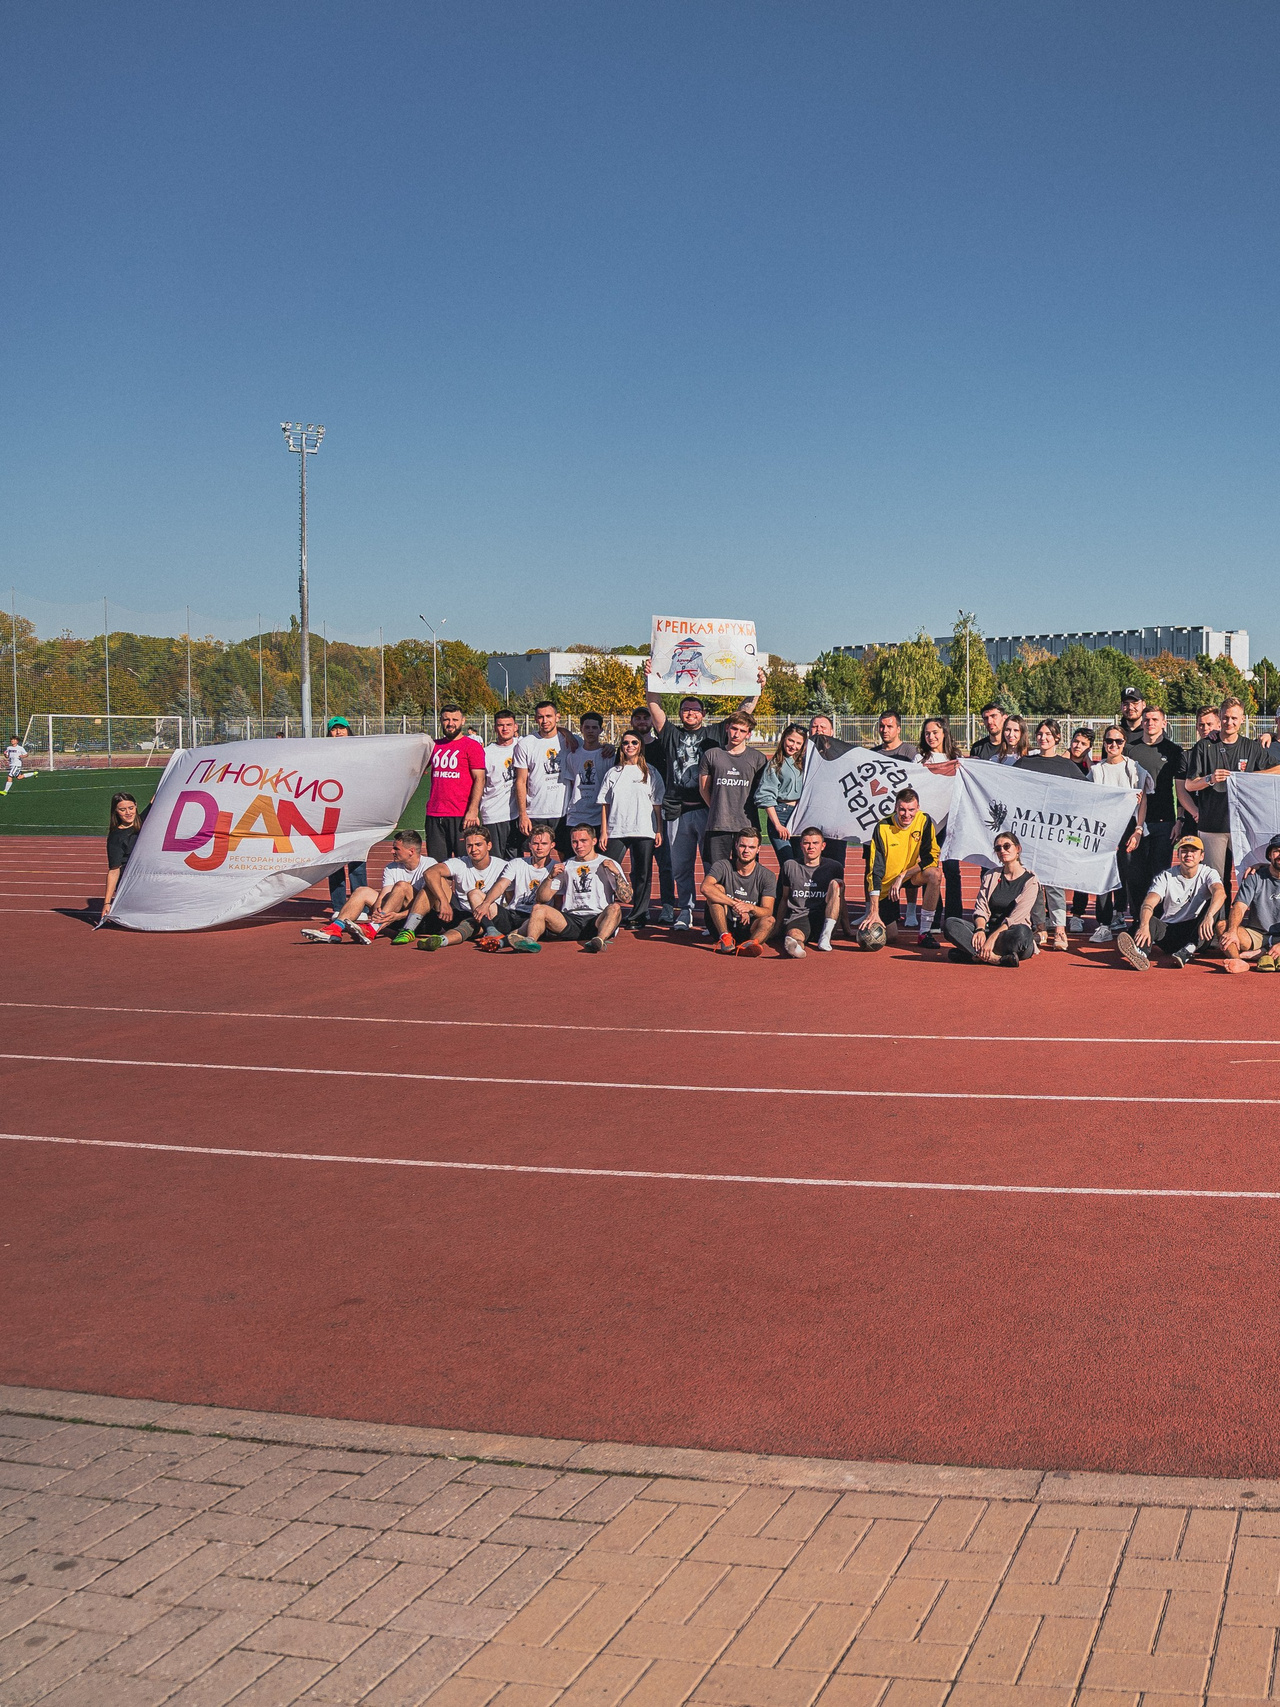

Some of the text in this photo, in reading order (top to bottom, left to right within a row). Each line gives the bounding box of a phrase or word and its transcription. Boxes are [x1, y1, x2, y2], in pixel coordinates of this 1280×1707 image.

[656, 619, 714, 635] КРЕПКАЯ
[432, 748, 460, 769] 666
[185, 758, 344, 803] ПИНОККИО
[716, 777, 750, 787] ДЭДУЛИ
[162, 790, 341, 872] DJAN
[1013, 806, 1107, 837] MADYAR
[1010, 821, 1101, 853] COLLECTION
[229, 855, 274, 863] РЕСТОРАН
